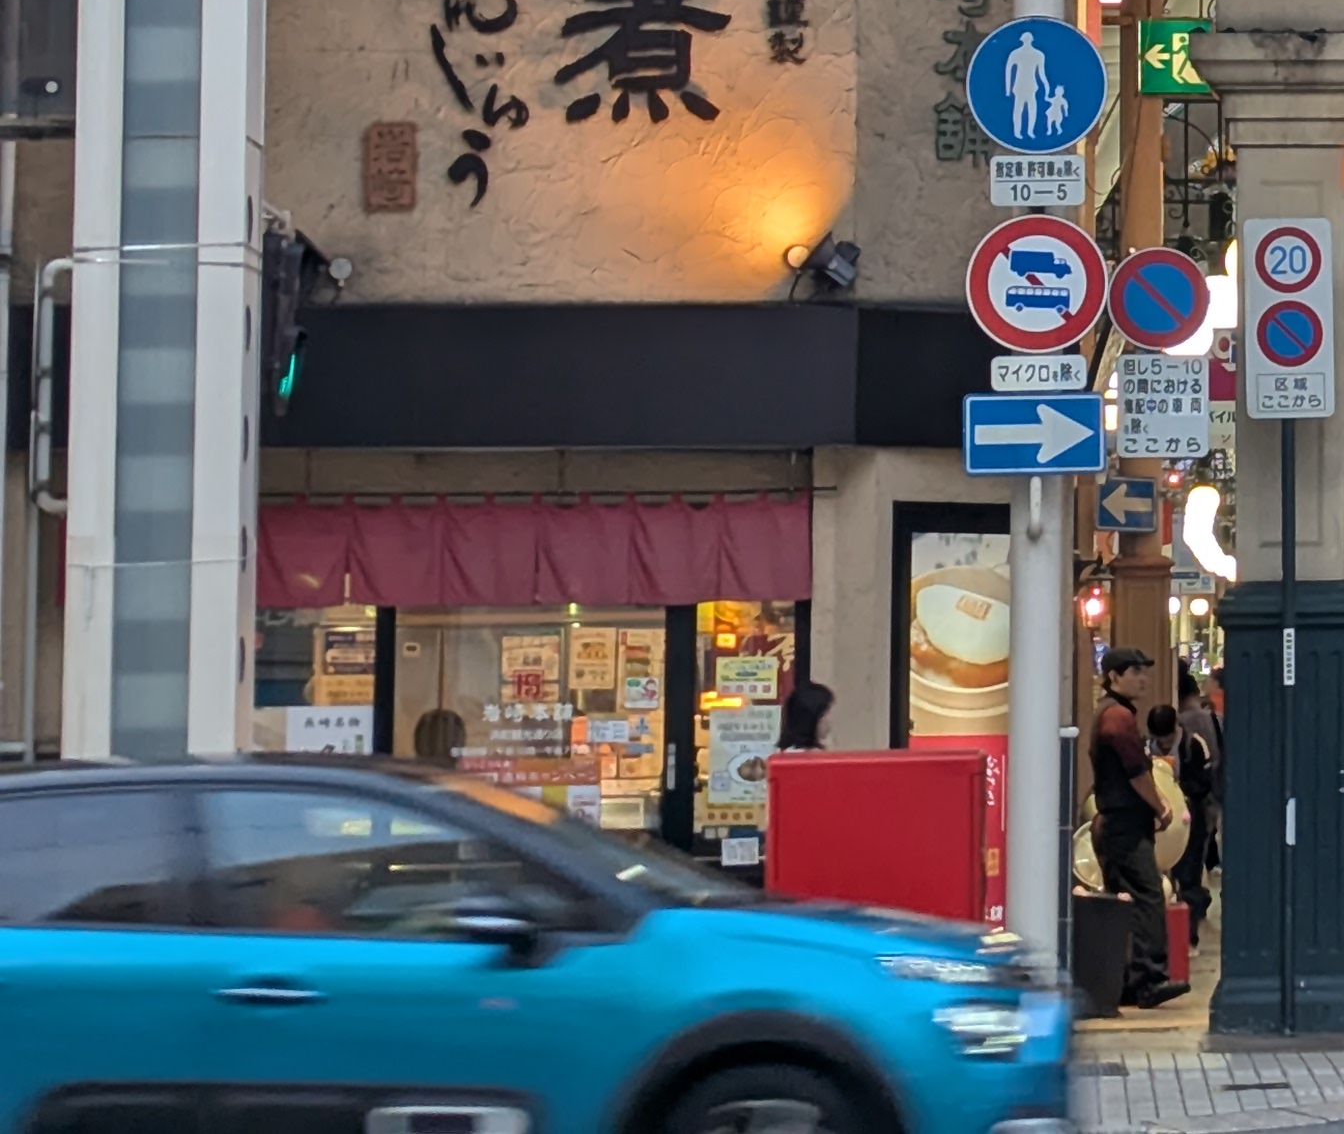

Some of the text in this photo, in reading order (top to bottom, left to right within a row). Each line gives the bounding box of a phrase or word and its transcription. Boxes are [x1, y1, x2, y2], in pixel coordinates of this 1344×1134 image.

[1269, 245, 1307, 275] 20
[997, 362, 1081, 383] マイクロを除く
[1123, 377, 1202, 395] の間における
[1261, 394, 1322, 409] ここから
[1123, 437, 1202, 454] ここから
